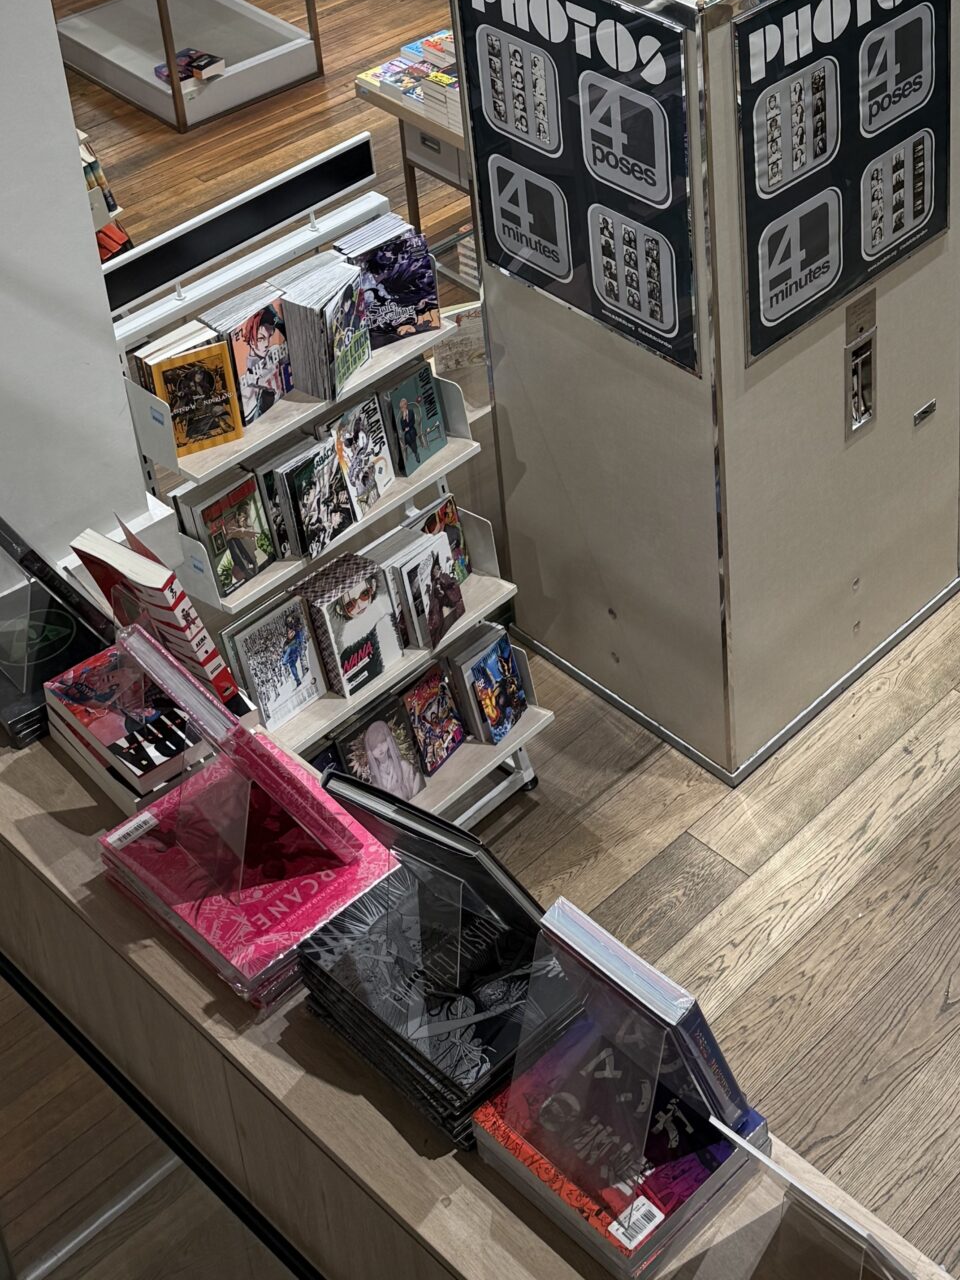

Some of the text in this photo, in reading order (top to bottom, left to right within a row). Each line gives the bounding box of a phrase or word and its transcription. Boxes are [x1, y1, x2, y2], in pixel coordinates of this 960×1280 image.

[866, 32, 901, 95] 4
[587, 83, 629, 153] 4
[867, 74, 924, 122] poses
[591, 140, 657, 188] poses
[500, 165, 535, 228] 4
[501, 220, 561, 265] minutes
[768, 222, 806, 282] 4
[769, 260, 832, 310] minutes
[361, 398, 386, 457] GALAXIAS
[342, 641, 374, 674] NANA
[251, 869, 337, 930] RCANE
